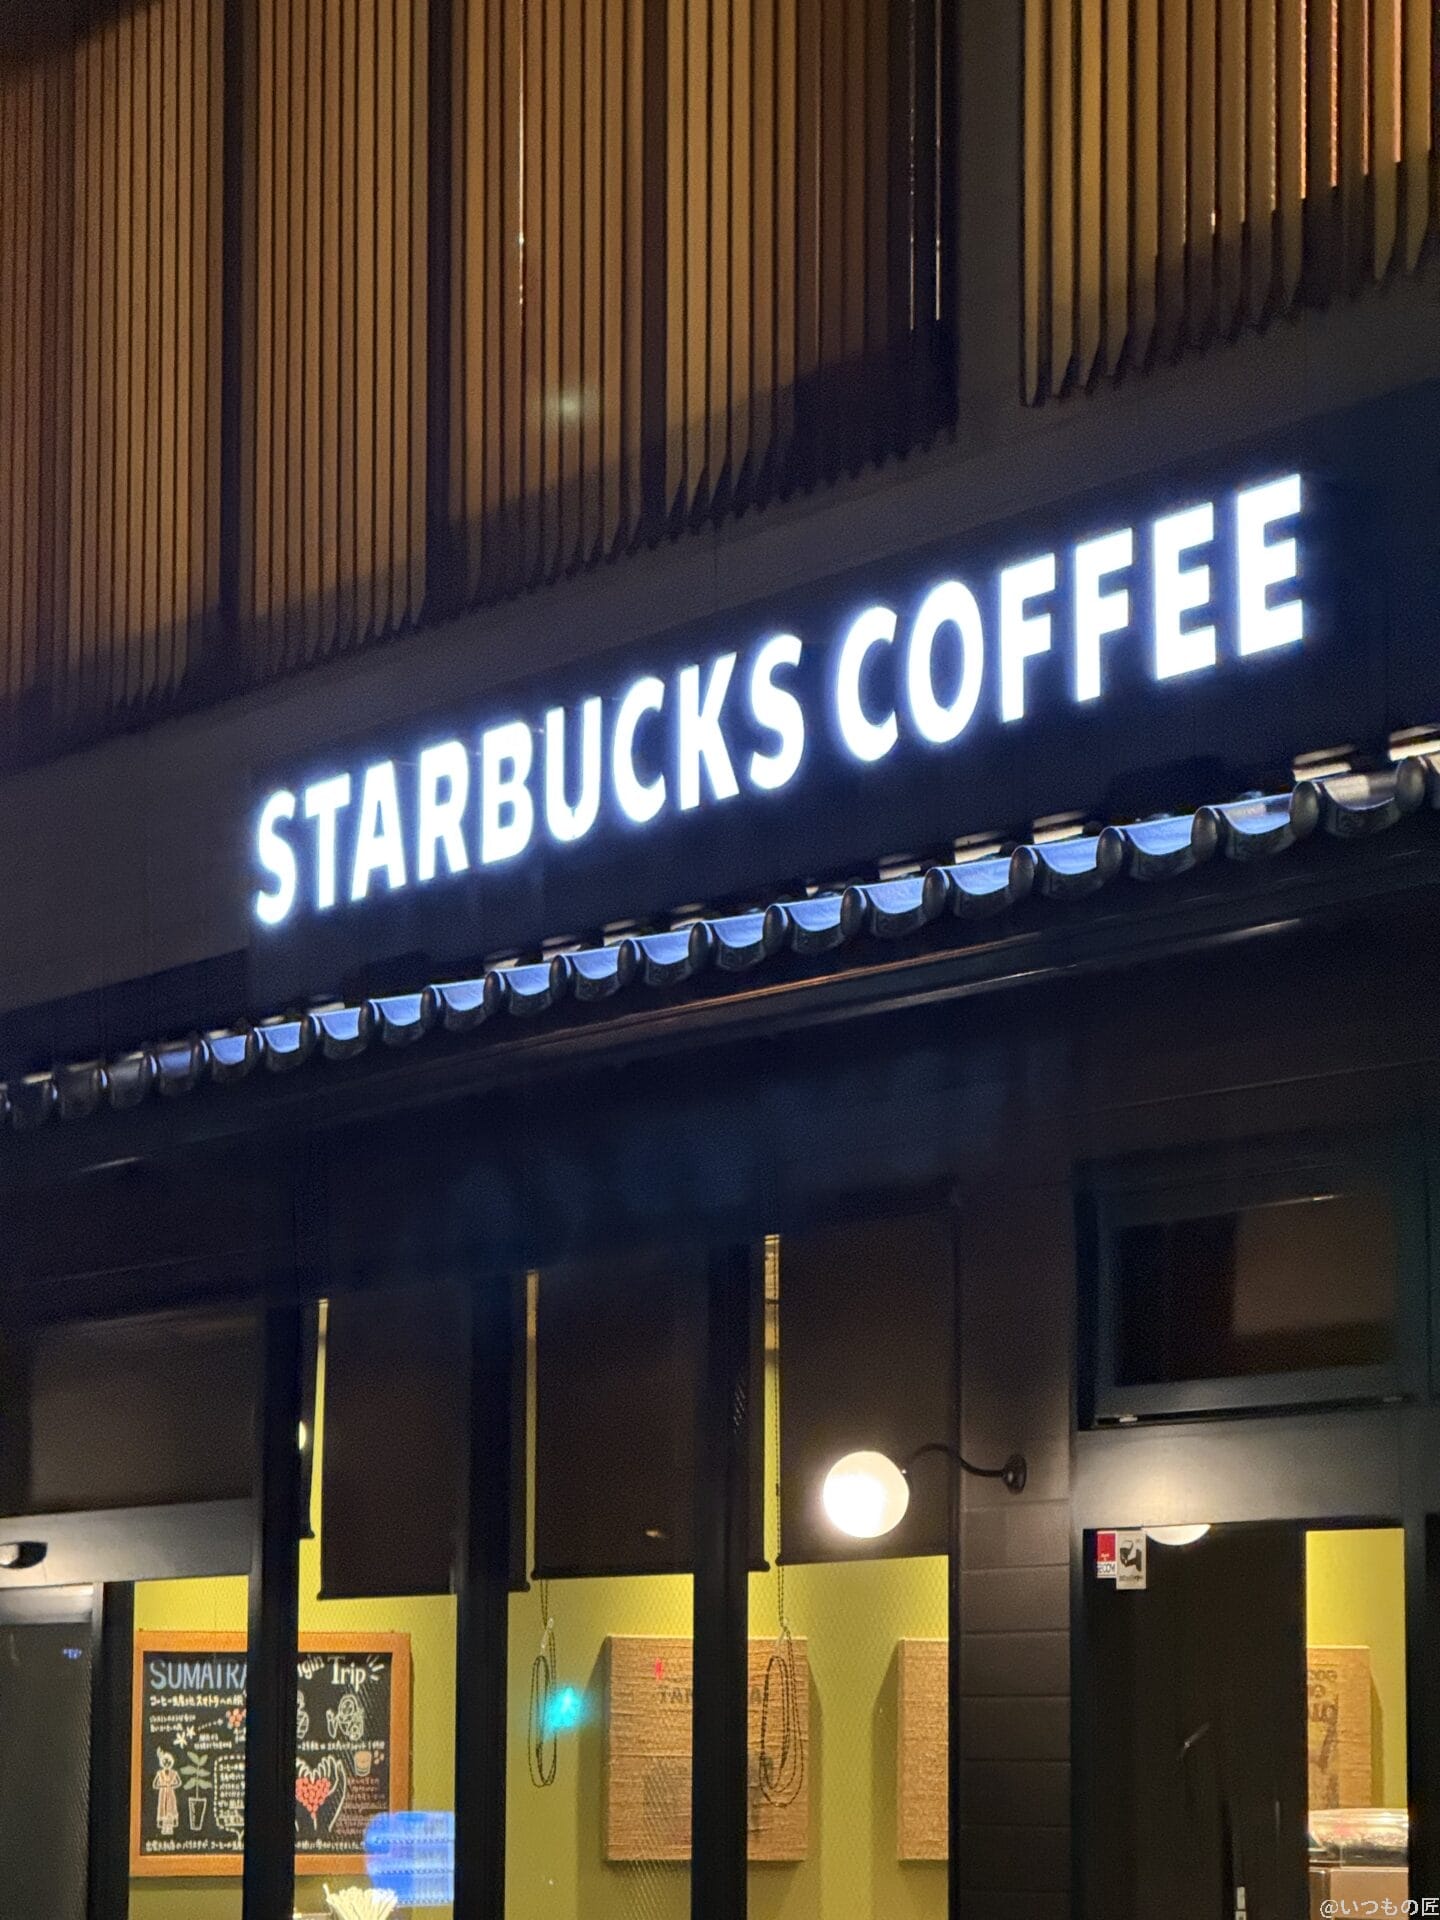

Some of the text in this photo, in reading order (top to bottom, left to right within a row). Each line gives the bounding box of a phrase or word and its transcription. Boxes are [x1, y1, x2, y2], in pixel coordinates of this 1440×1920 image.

[255, 473, 1305, 926] STARBUCKS COFFEE
[327, 1655, 367, 1692] Trip
